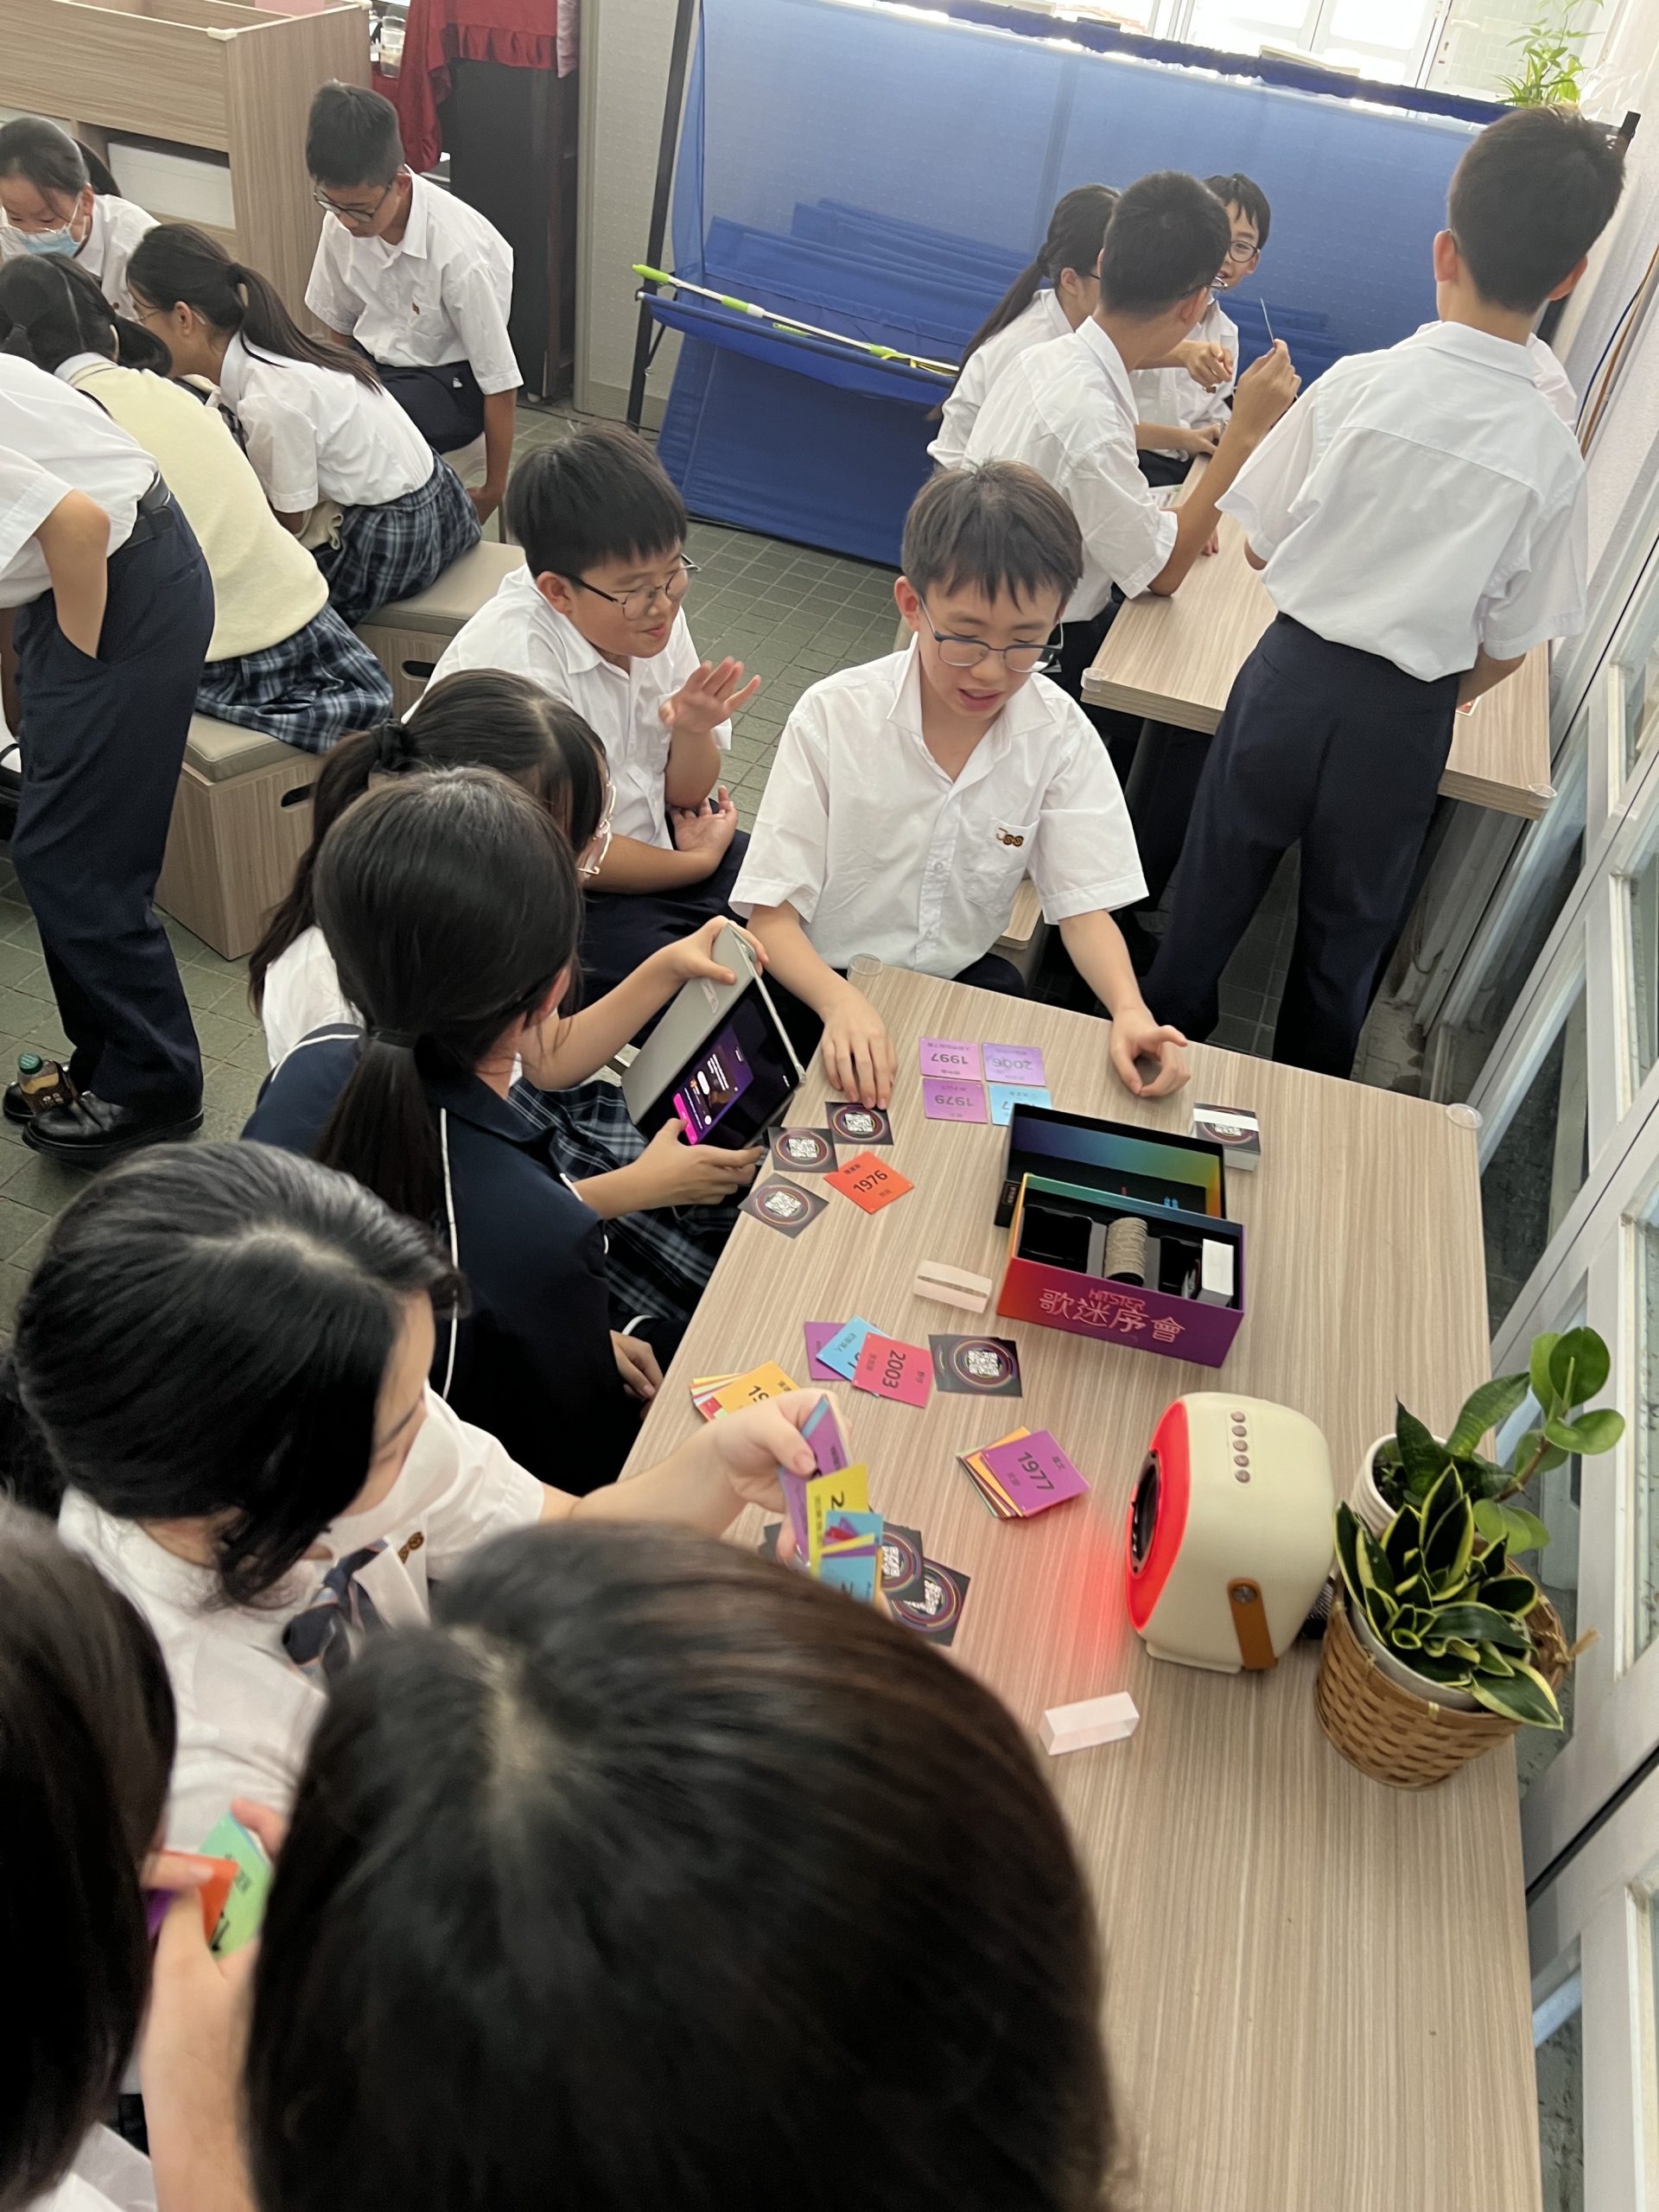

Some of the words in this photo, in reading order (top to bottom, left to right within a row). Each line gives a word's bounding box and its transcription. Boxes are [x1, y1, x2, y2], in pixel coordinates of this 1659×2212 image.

[931, 1052, 969, 1065] 1997
[934, 1094, 974, 1107] 1979
[853, 1169, 888, 1193] 1976
[1039, 1287, 1186, 1343] 歌迷序會
[882, 1350, 906, 1389] 2003
[1018, 1452, 1055, 1490] 1977
